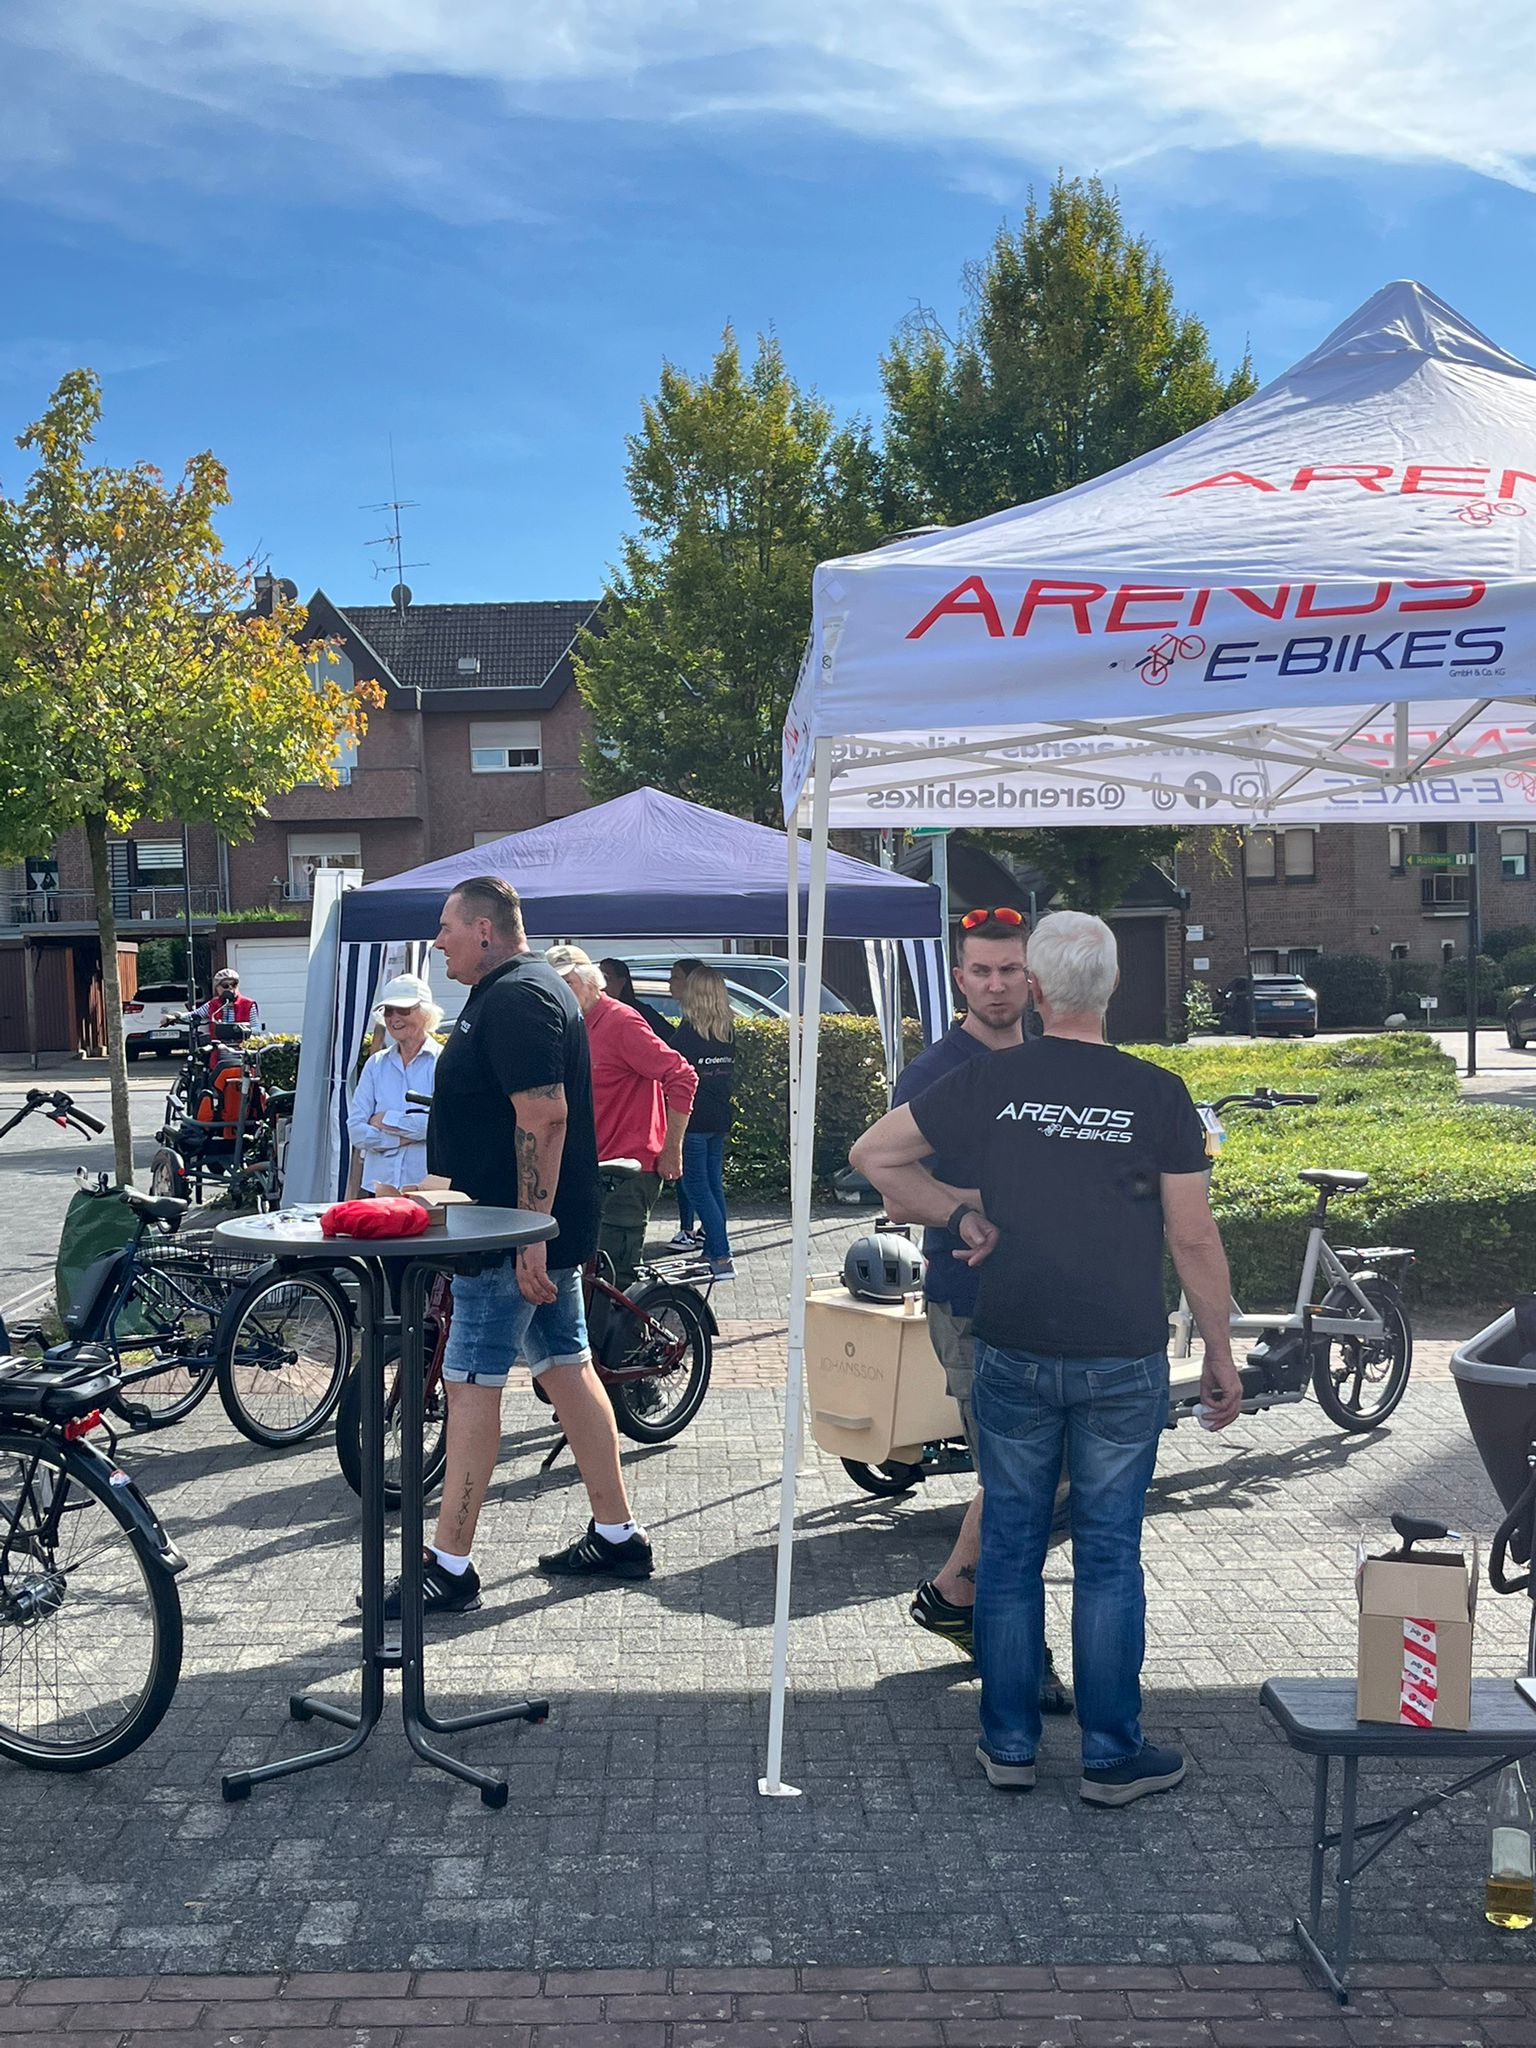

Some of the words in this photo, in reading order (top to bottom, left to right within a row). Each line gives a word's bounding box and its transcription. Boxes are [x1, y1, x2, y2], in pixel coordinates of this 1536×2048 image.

[905, 575, 1487, 640] ARENDS
[1203, 626, 1506, 682] E-BIKES
[1449, 669, 1472, 678] GmbH
[1474, 669, 1480, 677] &
[1495, 667, 1506, 676] KG
[1415, 855, 1452, 865] Rathaus
[996, 1102, 1134, 1129] ARENDS
[1059, 1126, 1133, 1143] E-BIKES
